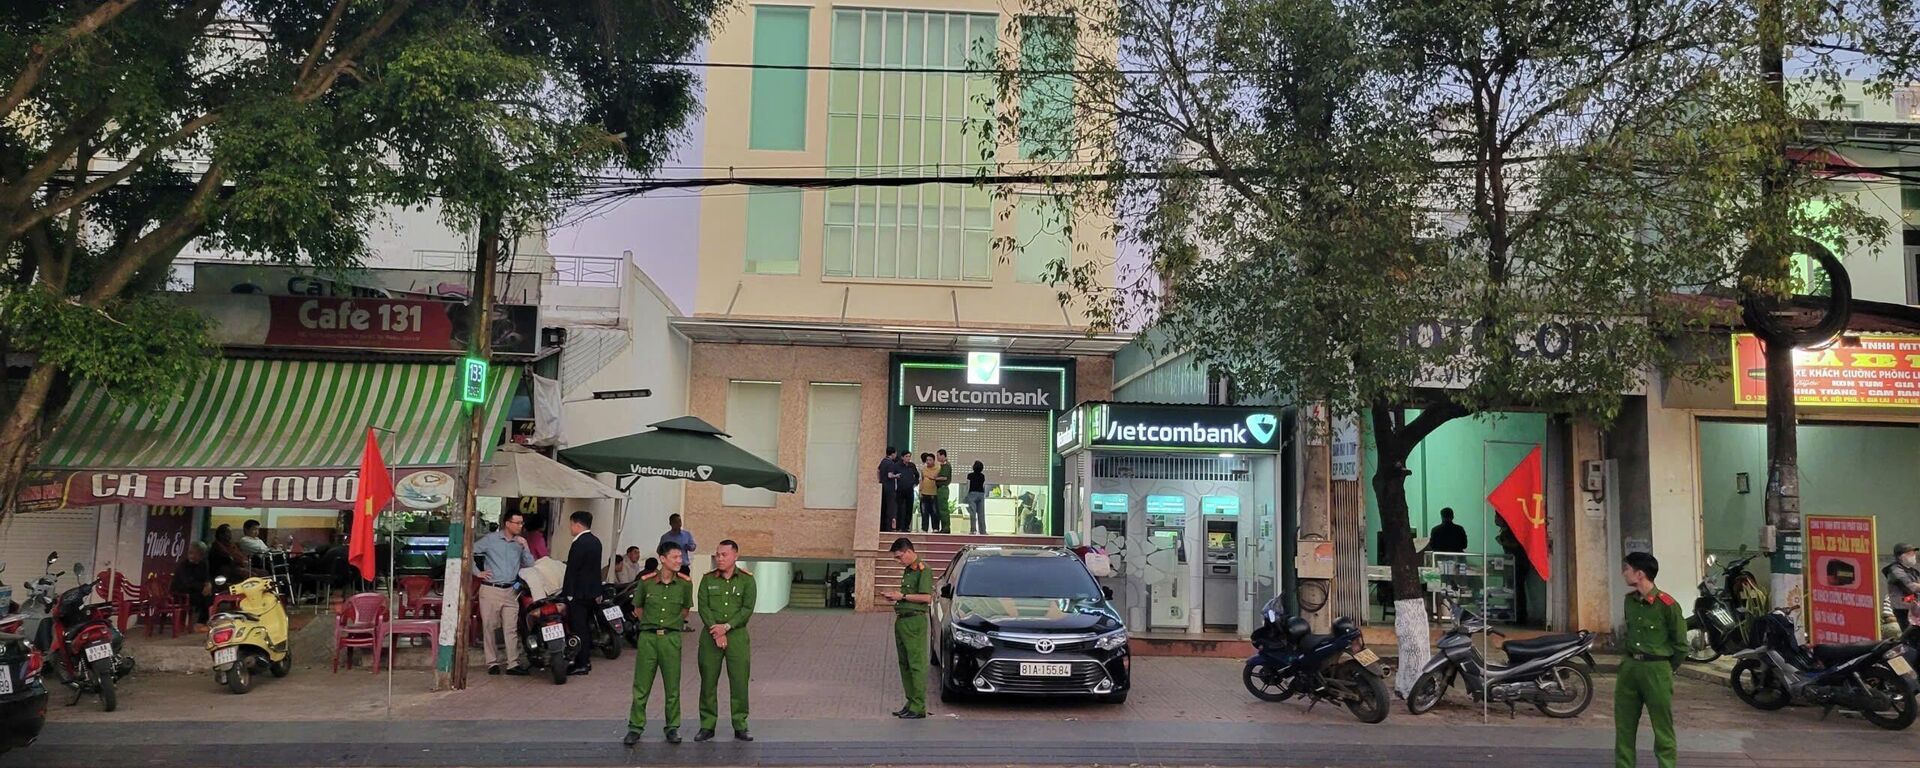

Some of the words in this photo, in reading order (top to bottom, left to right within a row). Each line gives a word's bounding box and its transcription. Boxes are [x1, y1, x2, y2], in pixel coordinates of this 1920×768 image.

[299, 300, 371, 331] Cafe
[378, 304, 422, 332] 131
[1810, 367, 1840, 378] KHÁCH
[1879, 368, 1911, 379] PHÒNG
[915, 385, 1049, 406] Vietcombank
[630, 463, 697, 479] Vietcombank
[163, 472, 248, 500] PHÊ
[261, 467, 361, 502] MUỐ
